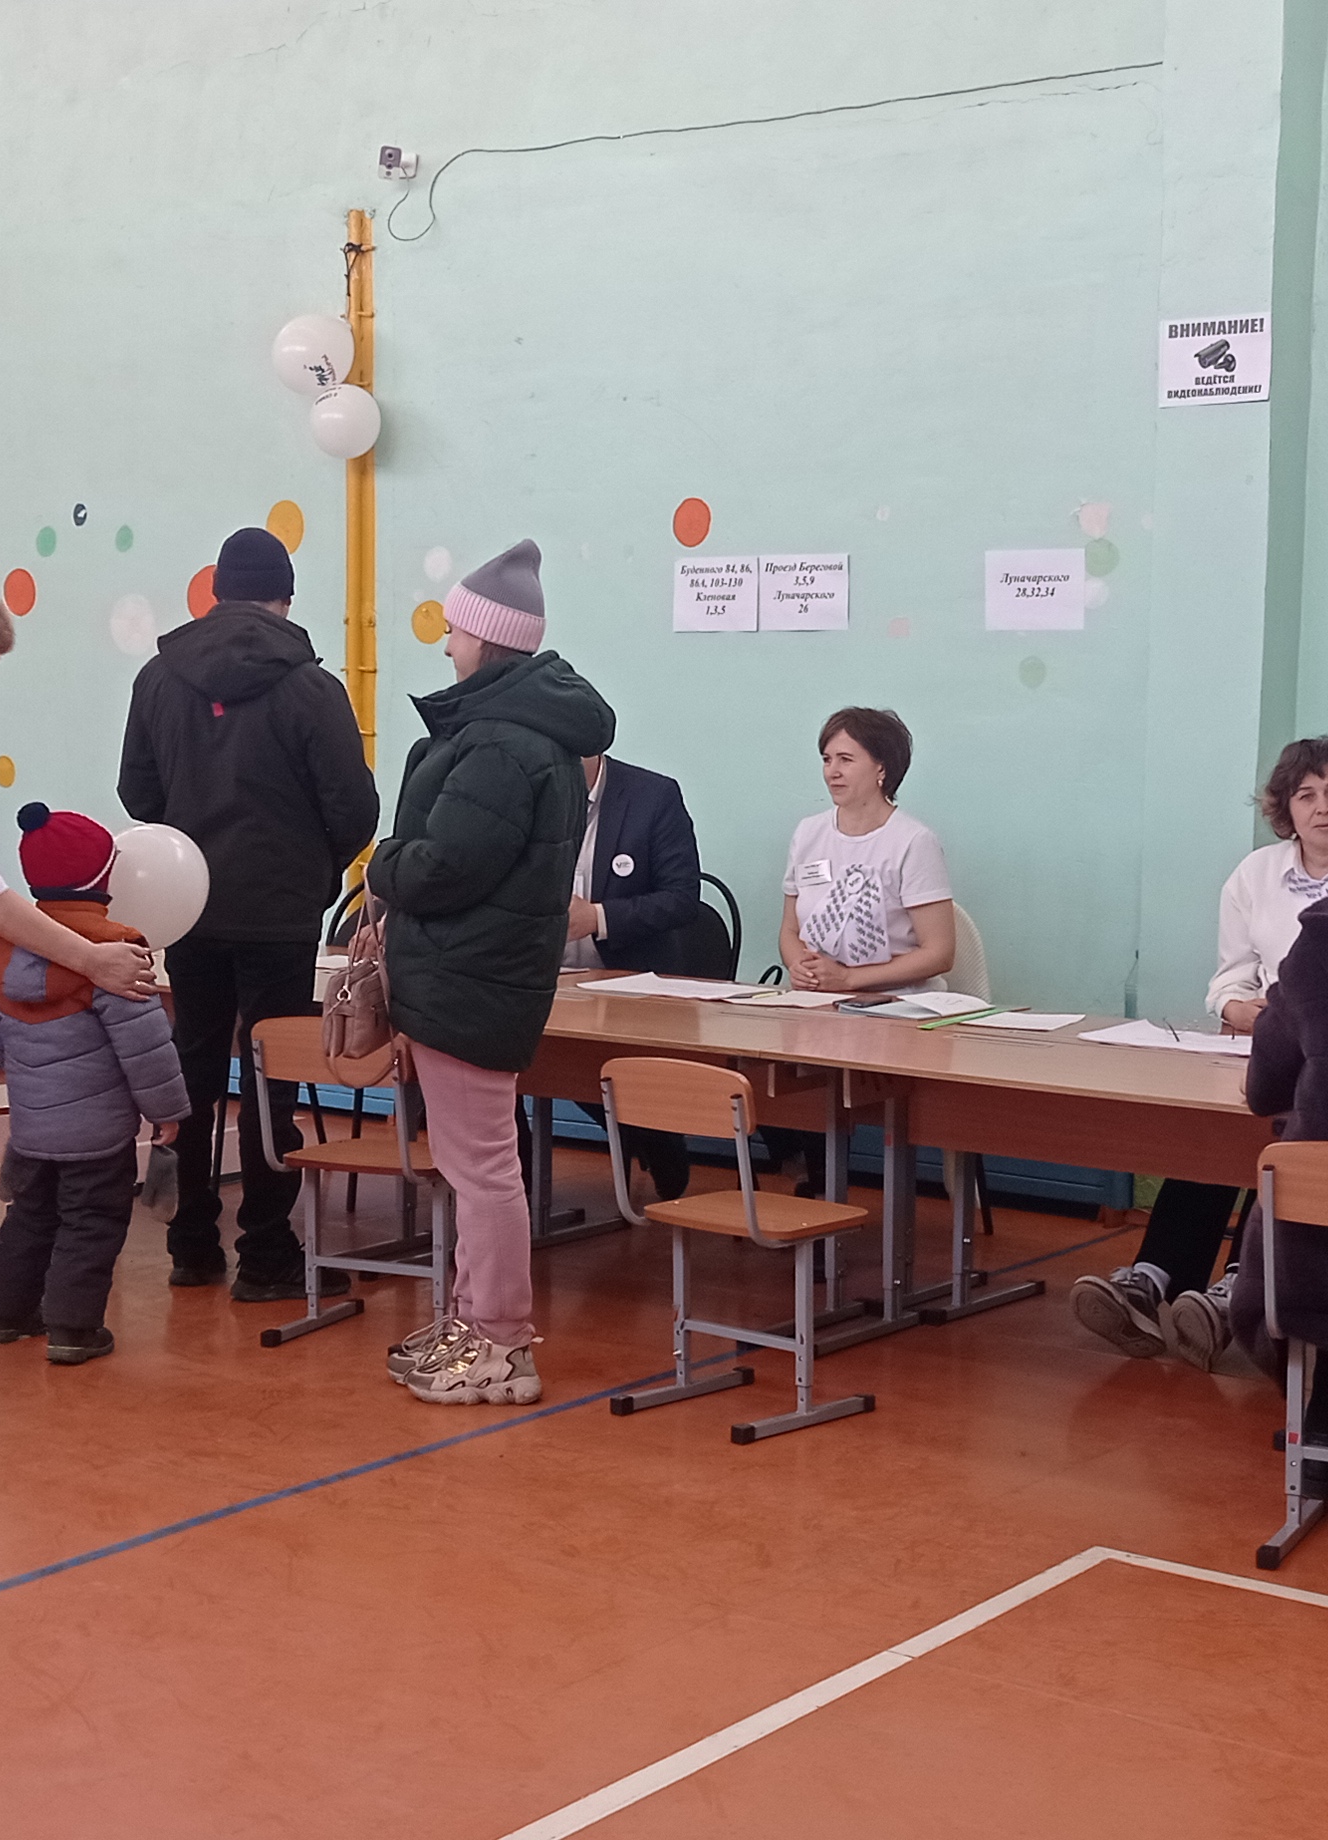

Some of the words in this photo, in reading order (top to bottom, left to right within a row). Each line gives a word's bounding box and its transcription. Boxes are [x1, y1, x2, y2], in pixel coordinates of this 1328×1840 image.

[1168, 318, 1264, 339] ВНИМАНИЕ!
[1167, 385, 1262, 399] ВИДЕОНАБЛЮДЕНИЕ!
[680, 565, 723, 575] Буденного
[725, 563, 738, 574] 84,
[740, 563, 753, 574] 86,
[764, 563, 797, 574] Проезд
[798, 562, 844, 574] Береговой
[710, 577, 743, 588] 103-130
[793, 576, 815, 586] 3,5,9
[1000, 573, 1070, 585] Луначарского
[773, 590, 835, 601] Луначарского
[1015, 587, 1056, 598] 28,32,34
[705, 605, 726, 616] 1,3,5
[798, 604, 809, 613] 26
